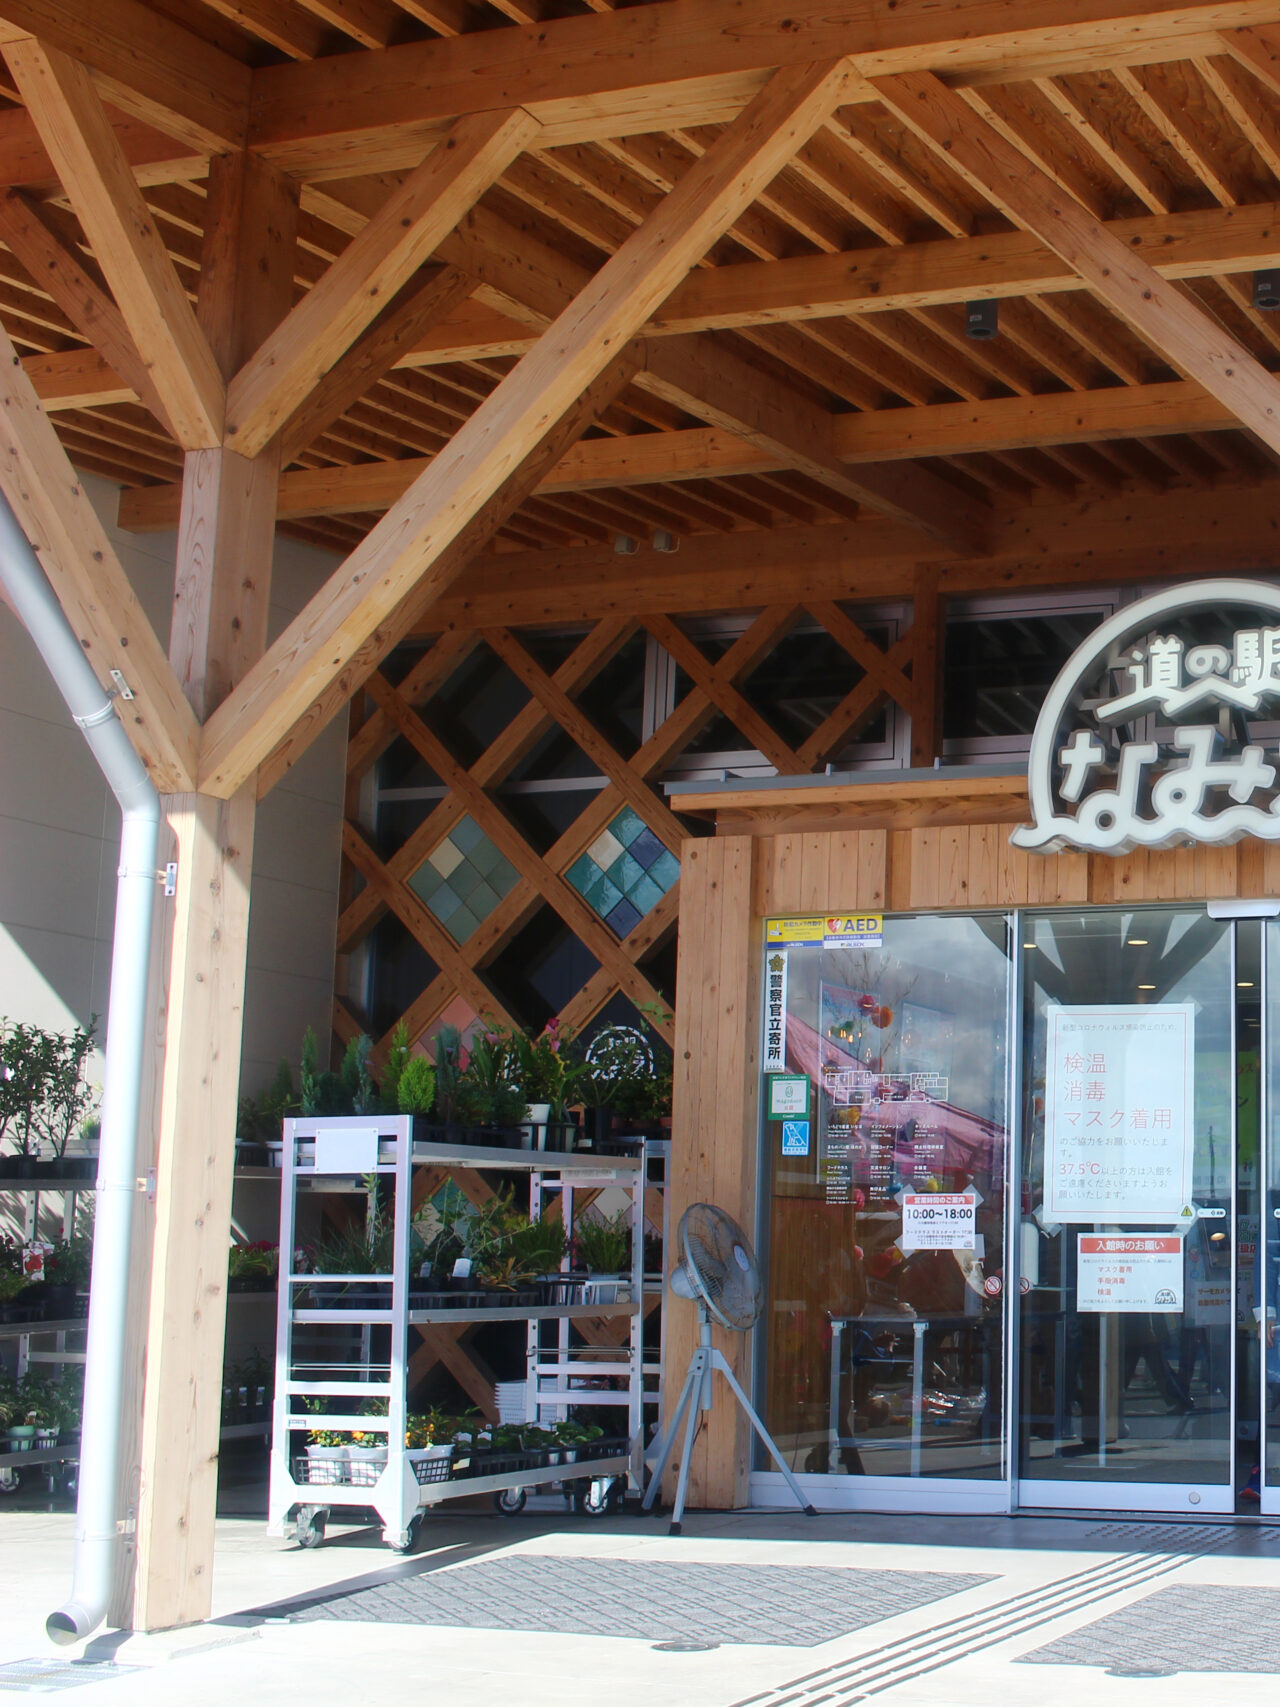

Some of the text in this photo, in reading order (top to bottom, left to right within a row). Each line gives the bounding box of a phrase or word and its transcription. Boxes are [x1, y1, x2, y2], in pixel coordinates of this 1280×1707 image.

[844, 918, 878, 932] AED
[768, 974, 783, 1061] 警察官立寄所
[1063, 1052, 1107, 1075] 検温
[1063, 1079, 1107, 1102] 消毒
[1064, 1107, 1173, 1131] マスク着用
[1095, 1239, 1166, 1252] 入館時のお願い
